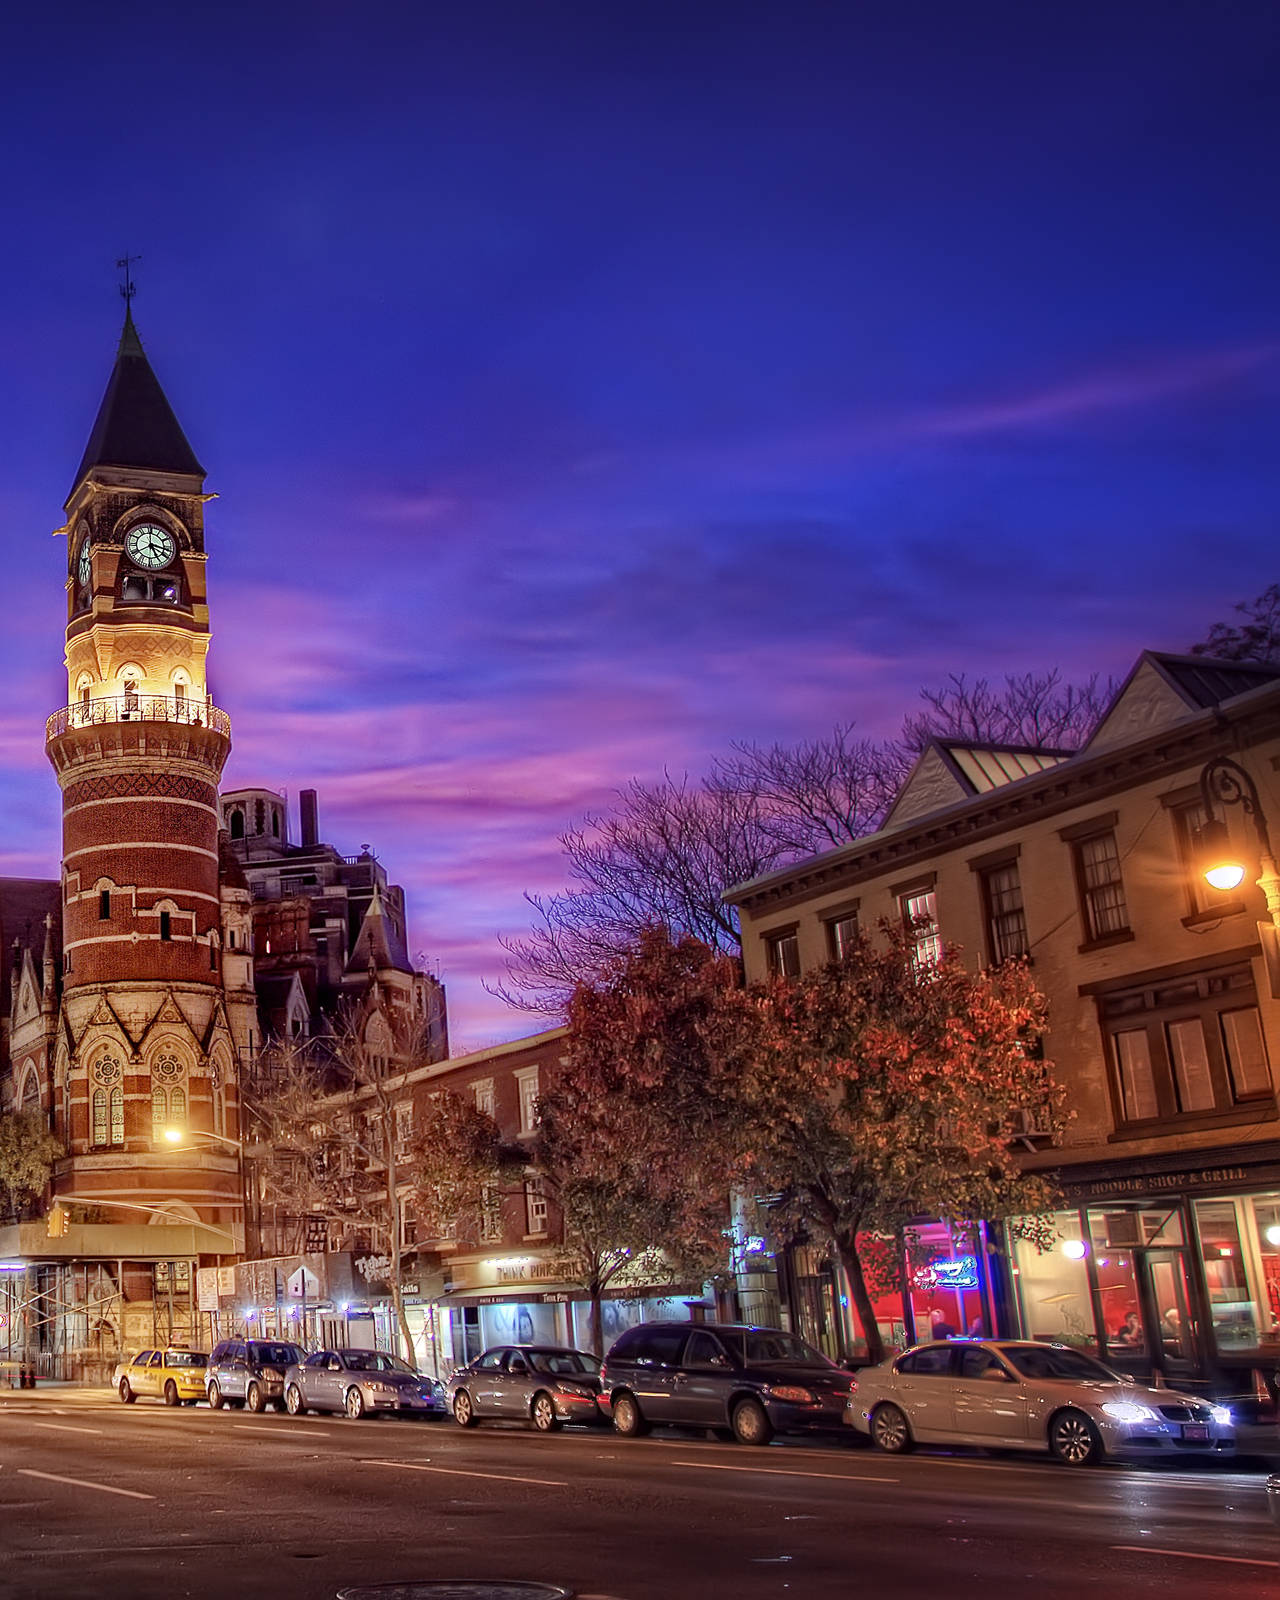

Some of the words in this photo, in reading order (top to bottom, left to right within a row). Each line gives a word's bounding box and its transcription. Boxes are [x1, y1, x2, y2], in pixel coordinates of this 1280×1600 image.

[1091, 1180, 1144, 1195] NOODLE
[1149, 1174, 1185, 1188] SHOP
[1189, 1174, 1200, 1184] &
[1202, 1168, 1247, 1182] GRILL
[496, 1266, 526, 1281] THINK
